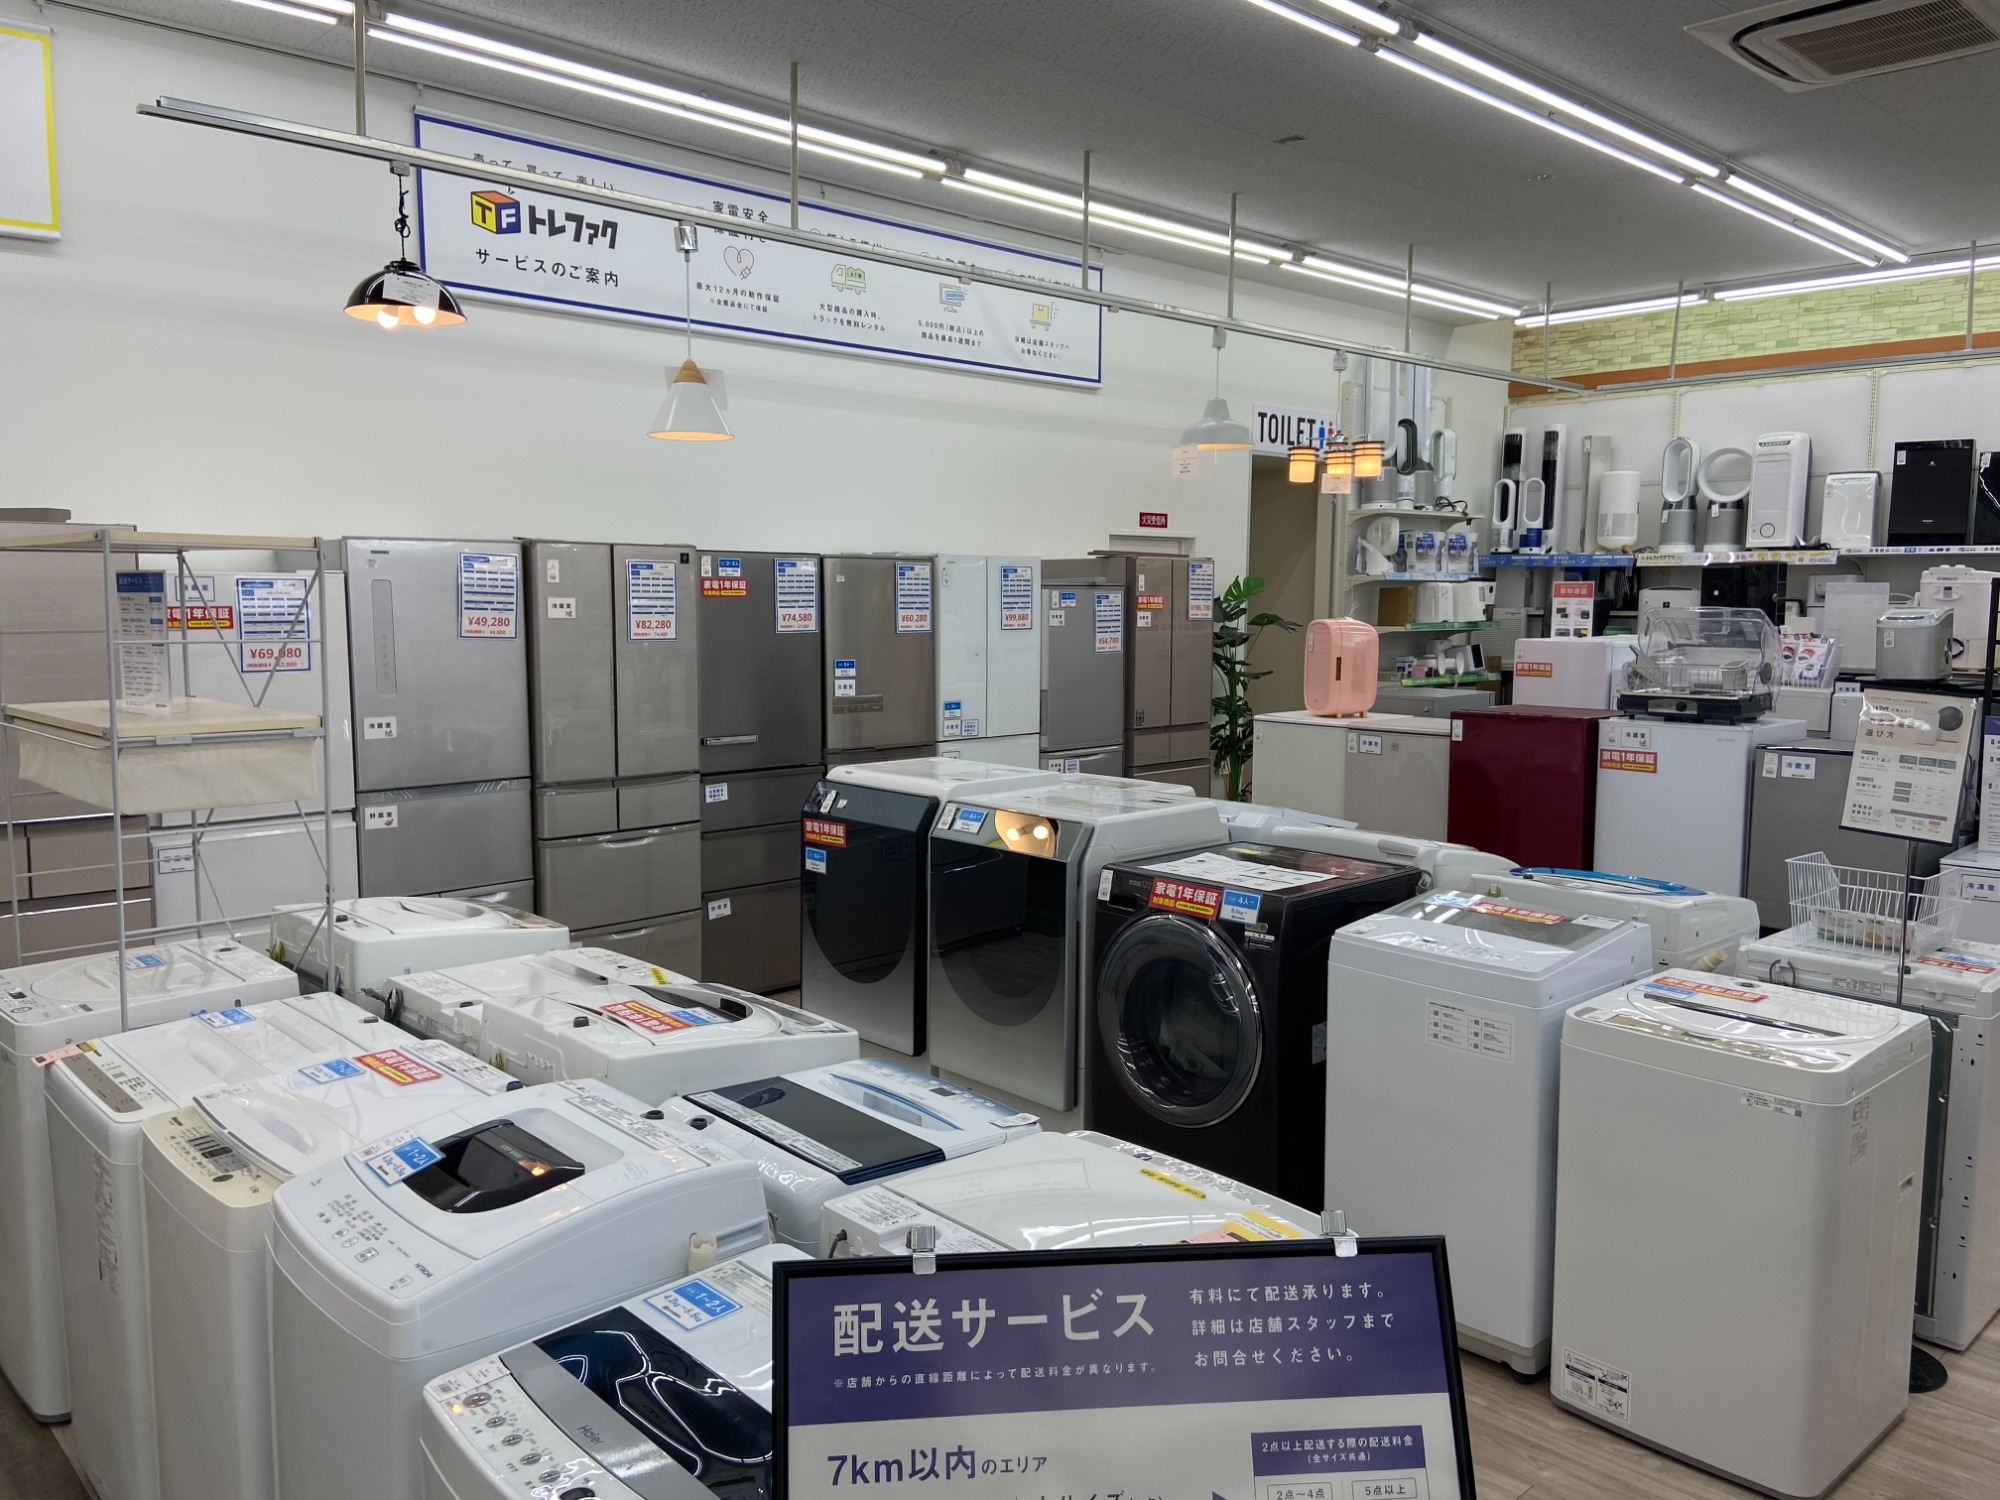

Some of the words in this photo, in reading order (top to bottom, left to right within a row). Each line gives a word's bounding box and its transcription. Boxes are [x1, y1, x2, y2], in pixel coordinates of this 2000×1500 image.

[528, 204, 618, 249] トレファク
[475, 247, 619, 288] サービスのご案内
[1257, 411, 1316, 447] TOILET
[467, 616, 510, 628] ¥49,280
[635, 619, 672, 631] ¥82,280
[1864, 728, 1895, 739] 選び方
[1602, 751, 1655, 764] 家電1年保証
[1785, 761, 1811, 771] 冷蔵室
[805, 821, 844, 836] 家電1年保証
[1155, 881, 1218, 906] 家電1年保証
[1966, 881, 1996, 892] 冷凍室
[1189, 1281, 1384, 1305] 有料にて配送承ります。
[832, 1288, 1155, 1357] 配送サービス
[1191, 1312, 1394, 1336] 詳細は店舗スタッフまで
[1194, 1346, 1354, 1367] お問合せください。
[833, 1360, 1158, 1389] ※店舗からの直線距離によって配送料金が異なります。
[577, 1423, 605, 1446] Haier
[1262, 1434, 1414, 1453] 2点以上配送する際の配送料金
[826, 1445, 1048, 1486] 7km以内のエリア
[1364, 1484, 1407, 1496] 5点以上
